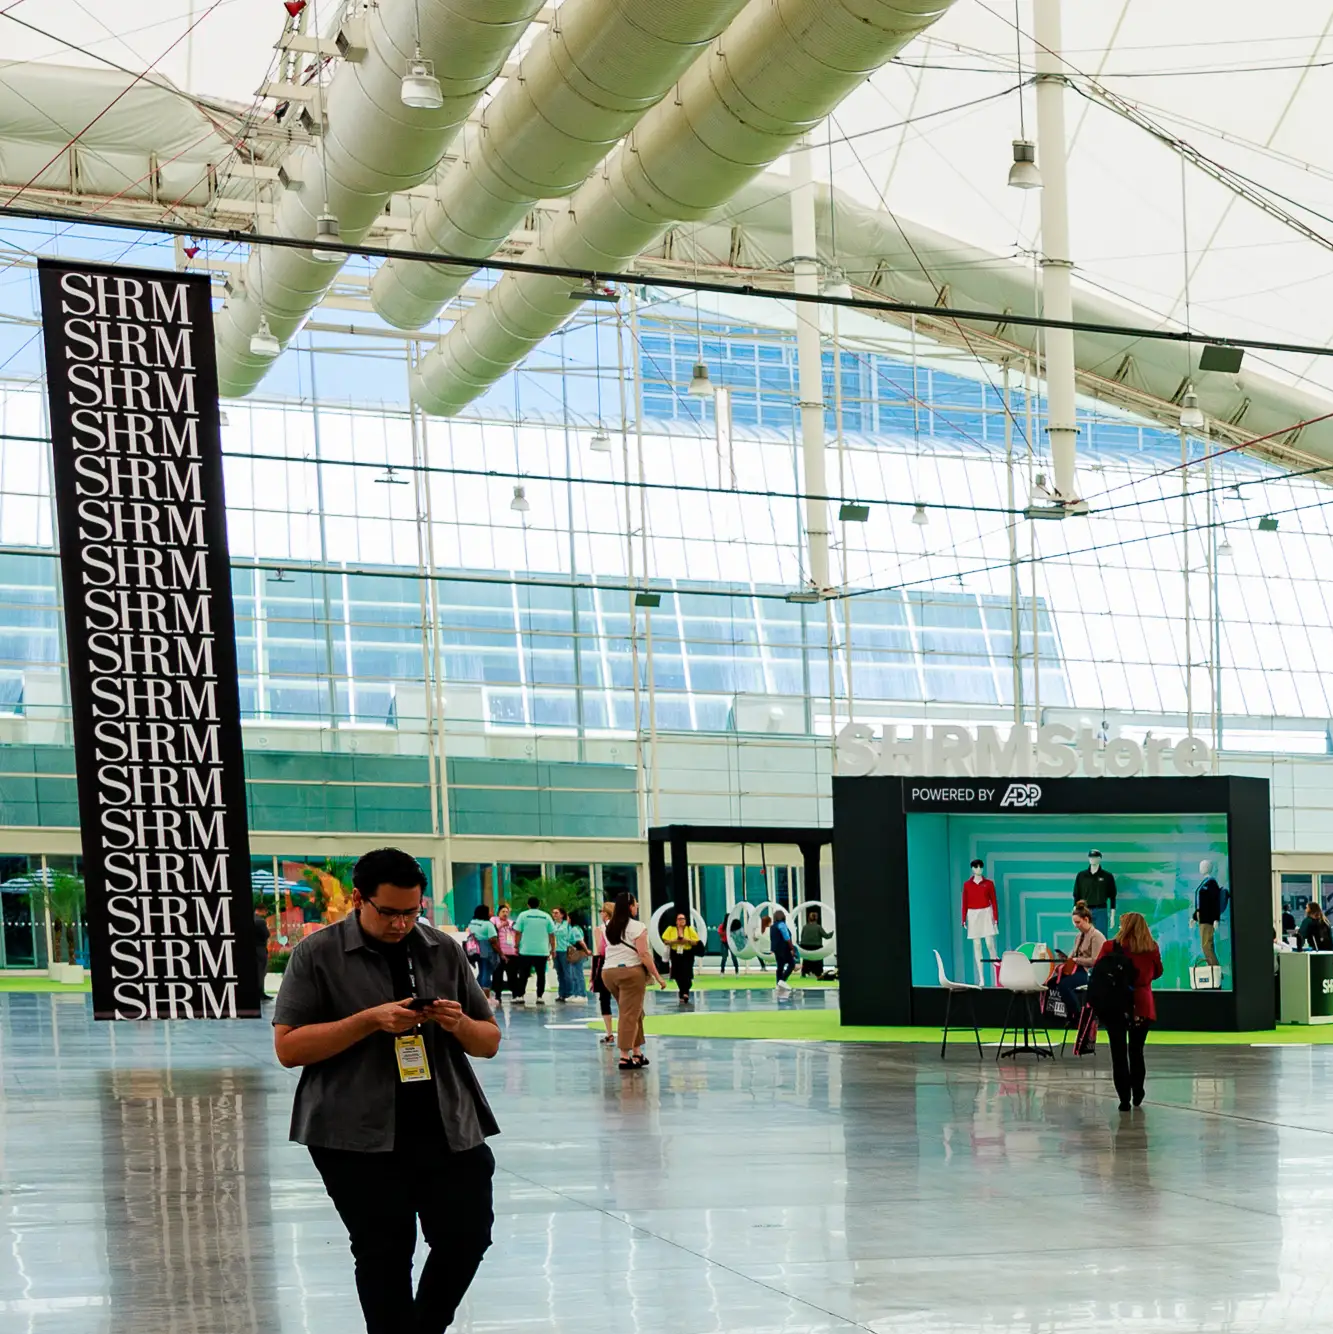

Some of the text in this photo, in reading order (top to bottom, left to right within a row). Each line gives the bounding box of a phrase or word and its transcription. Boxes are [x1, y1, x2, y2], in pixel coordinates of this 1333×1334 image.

[61, 273, 192, 325] SHRM
[65, 319, 195, 369] SHRM
[68, 364, 199, 414] SHRM
[71, 409, 202, 458] SHRM
[75, 455, 205, 503] SHRM
[78, 500, 208, 547] SHRM
[82, 544, 211, 590] SHRM
[85, 589, 214, 634] SHRM
[88, 633, 217, 677] SHRM
[92, 677, 220, 720] SHRM
[95, 721, 223, 763] SHRM
[836, 723, 1213, 778] SHRMStore
[98, 765, 226, 806] SHRM
[912, 783, 1042, 807] POWERED BY ADP
[101, 809, 229, 849] SHRM
[105, 852, 231, 893] SHRM
[108, 896, 234, 936] SHRM
[111, 939, 237, 979] SHRM
[114, 982, 240, 1020] SHRM
